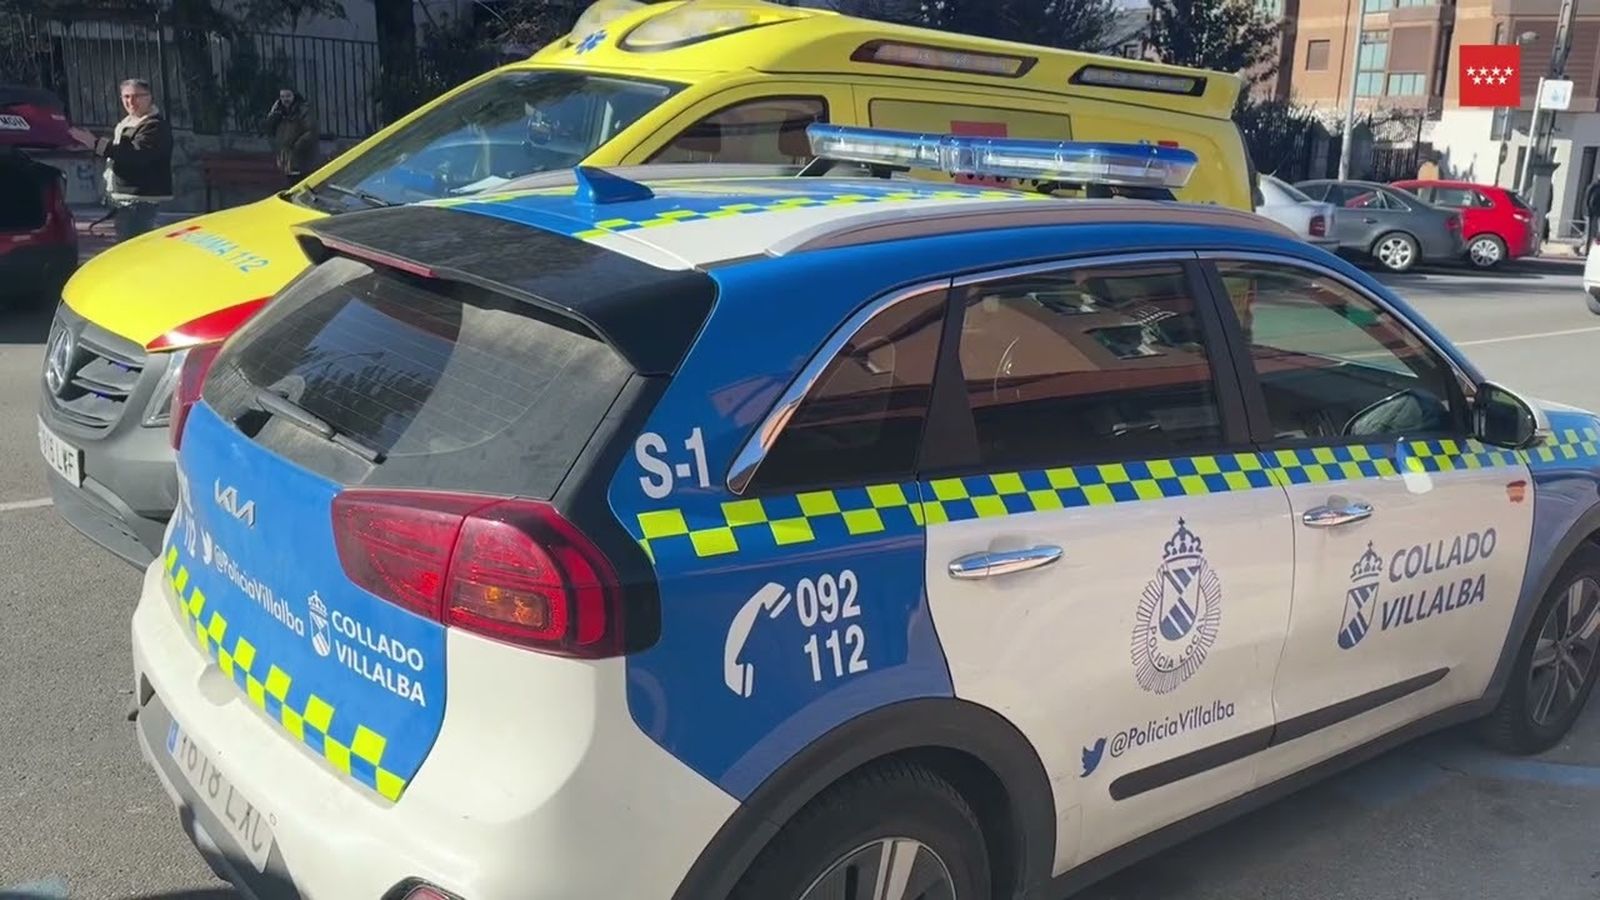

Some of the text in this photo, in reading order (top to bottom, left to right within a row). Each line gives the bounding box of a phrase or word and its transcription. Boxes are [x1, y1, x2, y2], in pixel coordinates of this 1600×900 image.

[228, 250, 269, 272] 112
[635, 427, 710, 499] S-1
[214, 477, 257, 529] KIA
[1389, 527, 1497, 583] COLLADO
[796, 569, 861, 628] 092
[1381, 573, 1486, 631] VILLALBA
[331, 610, 424, 672] COLLADO
[804, 624, 868, 682] 112
[335, 639, 427, 708] VILLALBA
[1110, 699, 1235, 758] @PoliciaVillalba
